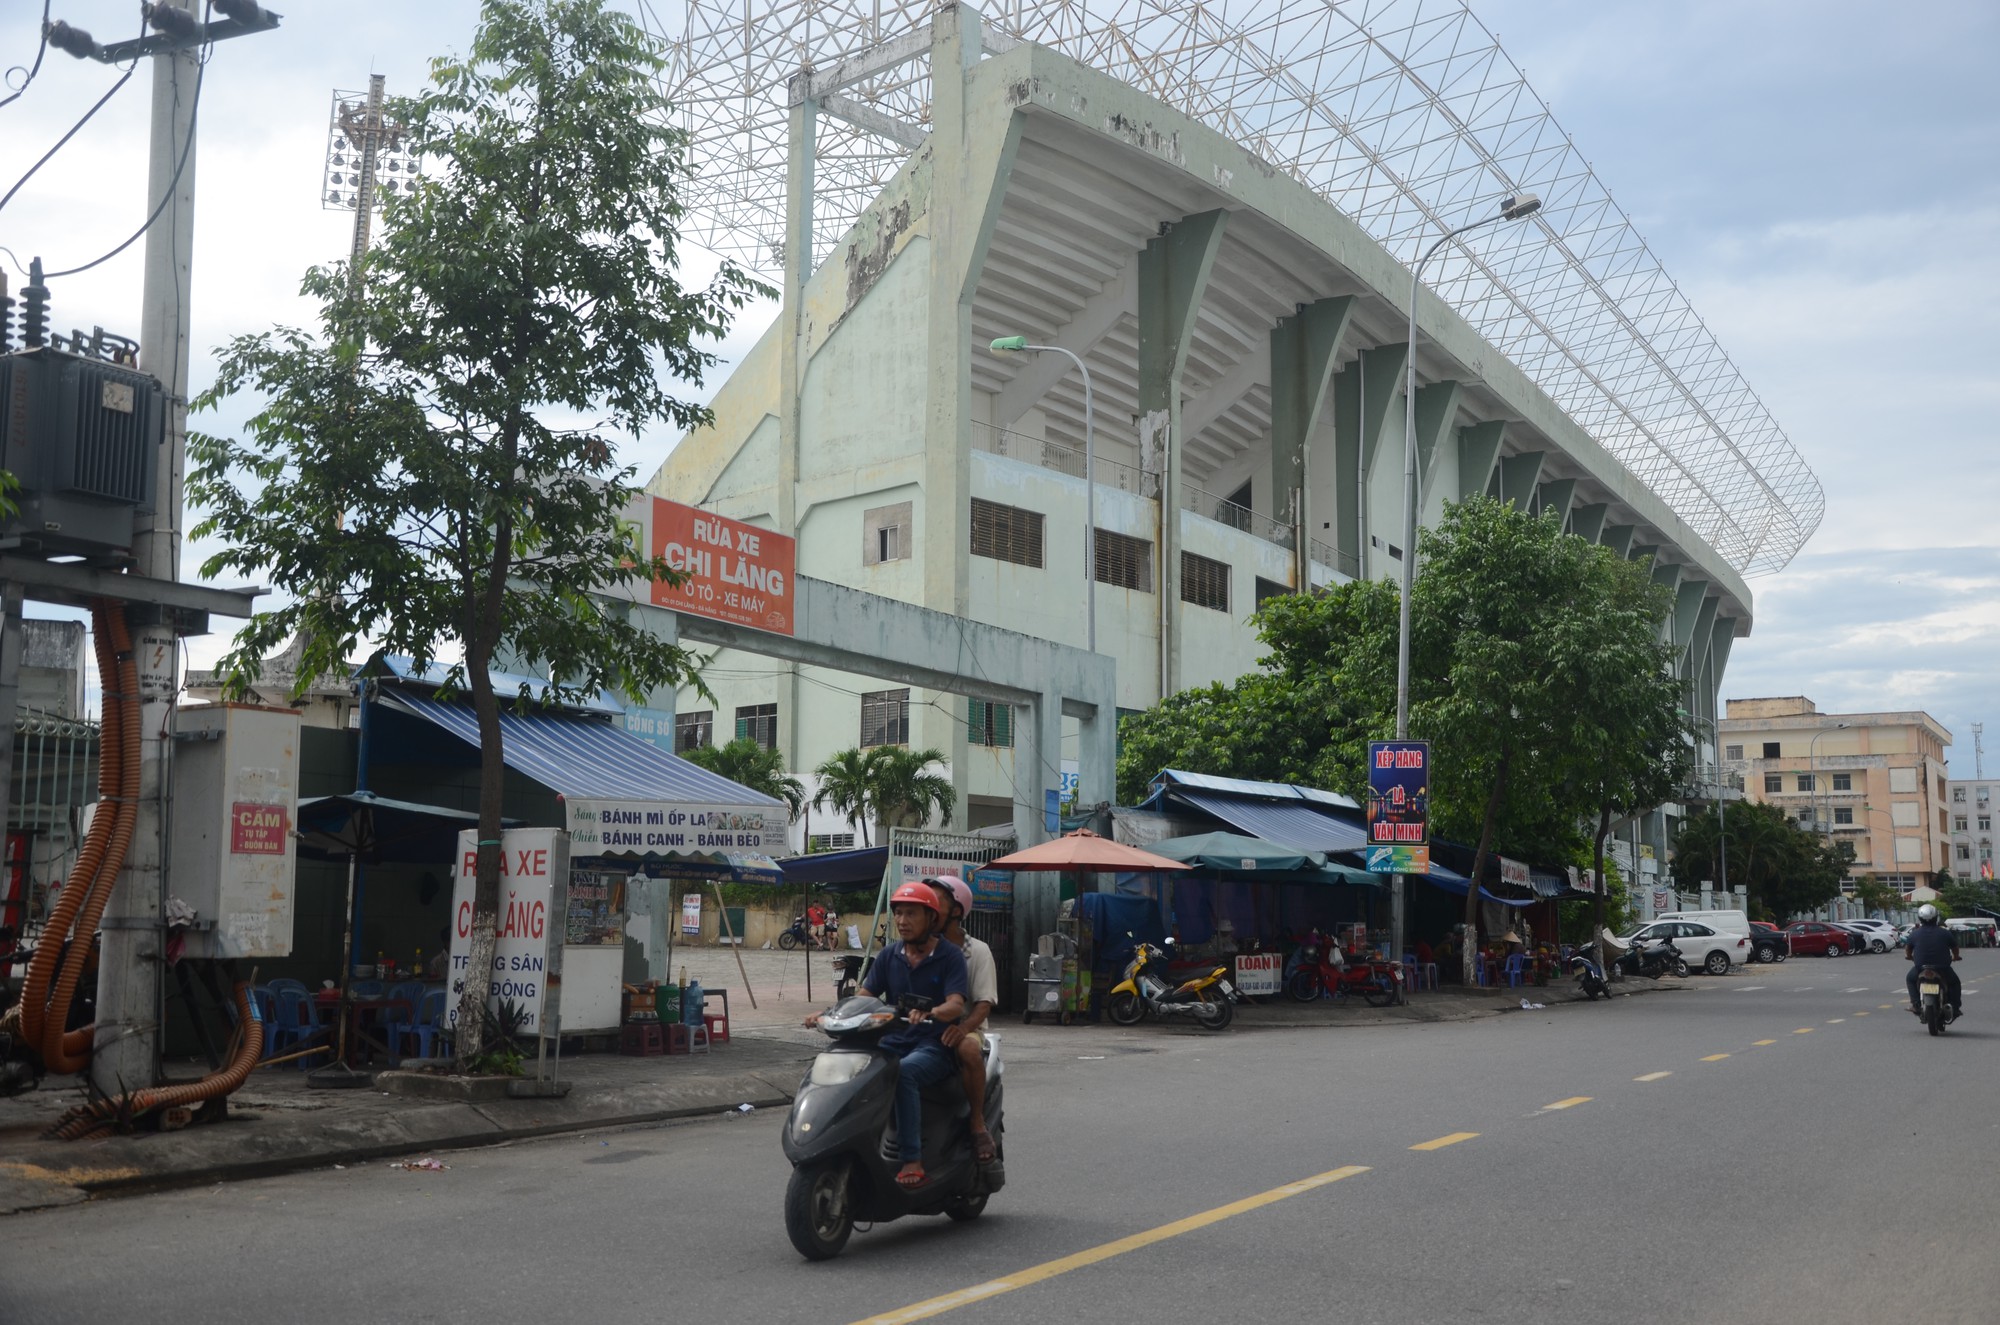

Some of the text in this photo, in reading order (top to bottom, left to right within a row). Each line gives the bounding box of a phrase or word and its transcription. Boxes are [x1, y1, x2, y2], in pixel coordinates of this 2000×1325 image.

[694, 517, 760, 557] RỬA XE
[664, 542, 784, 596] CHI LĂNG
[685, 579, 694, 597] Ô
[697, 583, 714, 601] TÔ
[724, 591, 738, 608] XE
[741, 595, 765, 614] MÁY
[627, 709, 669, 736] CỔNG SỐ
[1375, 745, 1422, 768] XẾP HÀNG
[1392, 784, 1405, 804] LÀ
[240, 808, 280, 828] CẤM
[647, 810, 663, 825] MÌ
[668, 809, 686, 825] ỐP
[691, 813, 706, 826] LA
[244, 829, 254, 840] TỤ
[255, 828, 268, 840] TẬP
[647, 833, 684, 846] CANH
[698, 831, 733, 846] BÁNH
[737, 832, 760, 847] BÈO
[1373, 820, 1422, 841] VĂN MINH
[463, 849, 547, 877] RA XE
[921, 865, 928, 875] XE
[929, 866, 935, 875] RA
[511, 953, 543, 971] SÂN
[491, 978, 536, 1000] ĐỘNG
